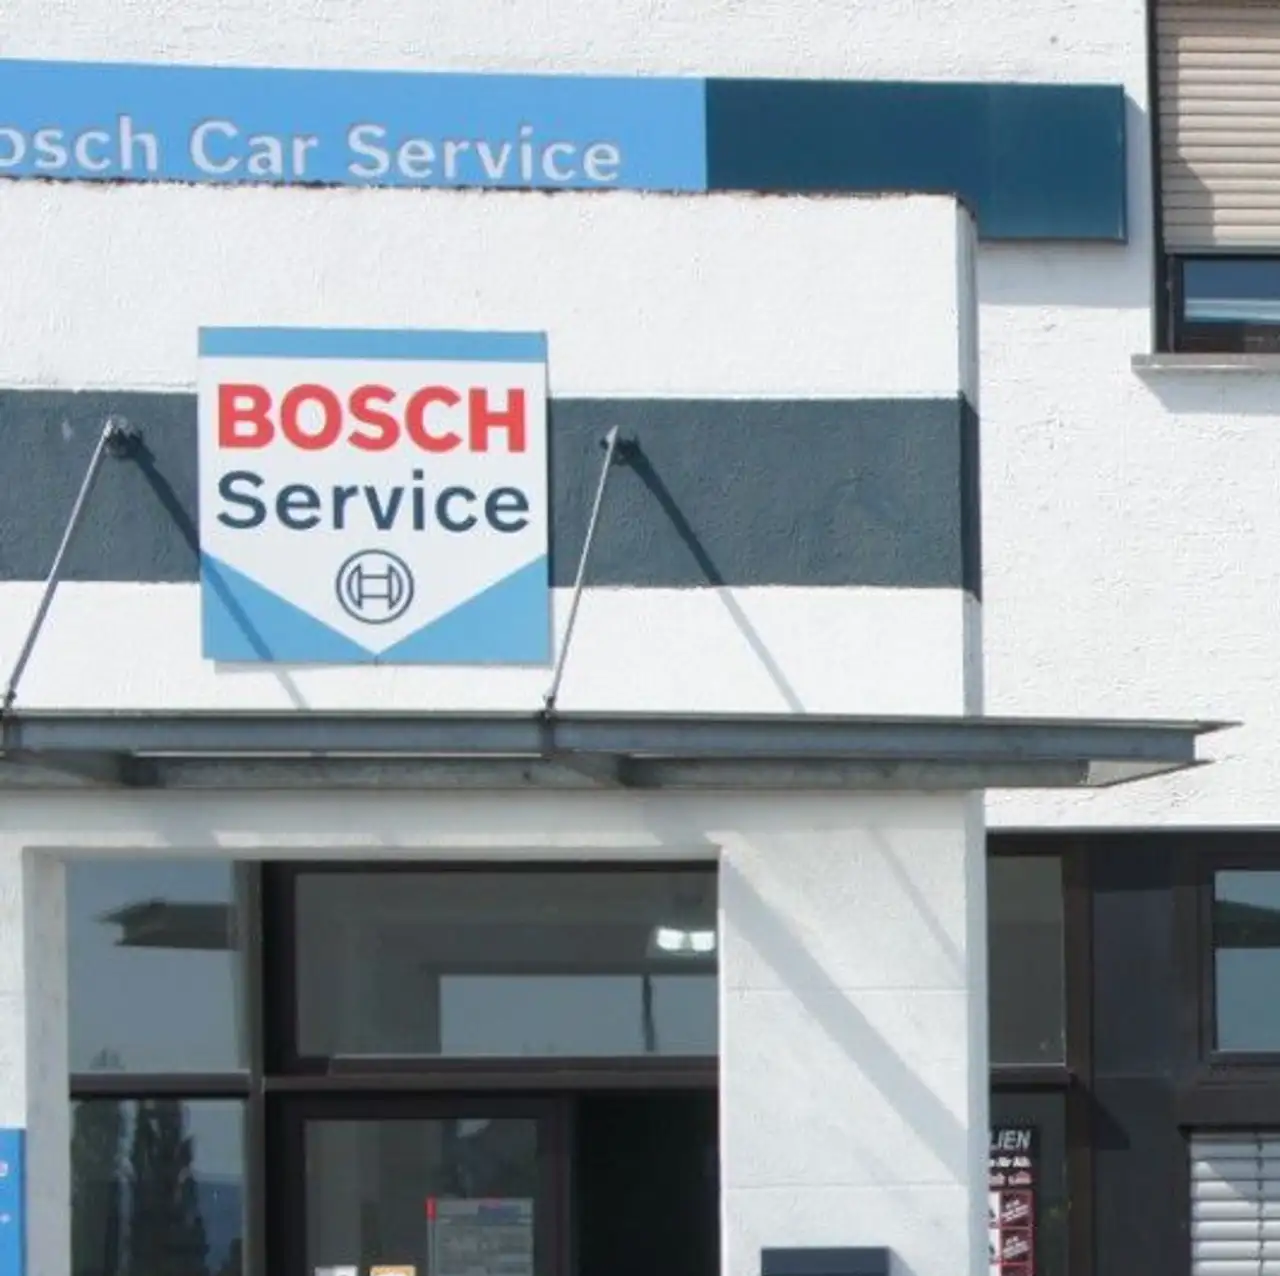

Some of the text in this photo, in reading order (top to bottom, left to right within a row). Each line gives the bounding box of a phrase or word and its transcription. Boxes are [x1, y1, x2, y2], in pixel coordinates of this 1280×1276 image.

[190, 119, 319, 175] Car
[347, 123, 622, 183] Service
[217, 383, 526, 453] BOSCH
[216, 468, 530, 533] Service
